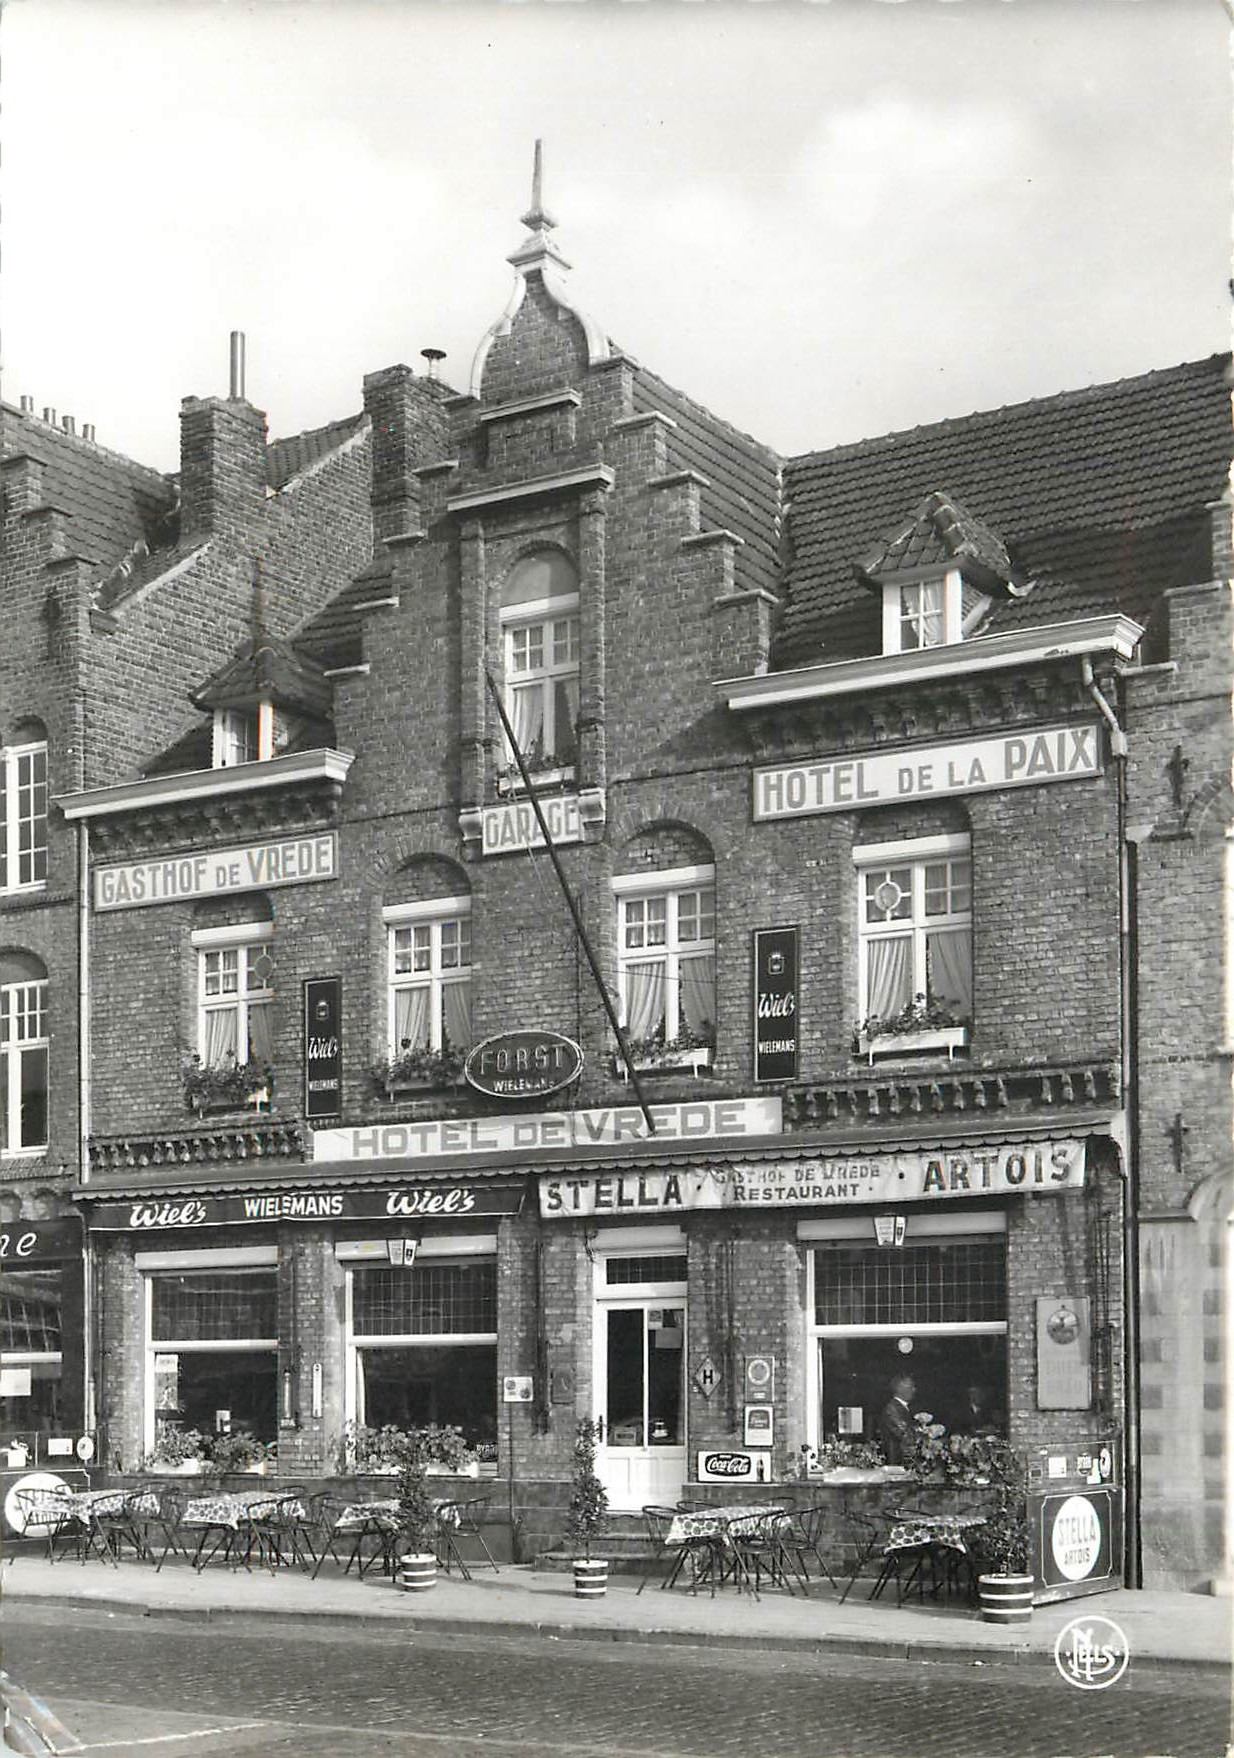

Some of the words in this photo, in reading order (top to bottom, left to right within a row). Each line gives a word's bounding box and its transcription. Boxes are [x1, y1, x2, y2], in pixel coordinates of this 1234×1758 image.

[763, 763, 879, 812] HOTEL
[899, 765, 933, 795] DE
[948, 758, 987, 787] LA
[1004, 729, 1094, 780] PAIX
[101, 858, 207, 903] GASTHOF
[216, 863, 240, 888] DE
[247, 839, 331, 883] VREDE
[481, 1043, 567, 1075] FORST
[758, 1040, 795, 1054] WIELEMANS
[352, 1122, 498, 1157] HOTEL
[513, 1121, 566, 1146] DE
[582, 1102, 746, 1142] VREDE
[547, 1175, 683, 1210] STELLA
[923, 1149, 1073, 1192] ARTOIS
[794, 1167, 816, 1182] DE
[130, 1201, 207, 1227] Wiel's
[244, 1195, 344, 1218] WIELEMANS
[386, 1189, 476, 1214] Wiel's
[734, 1183, 860, 1201] RESTAURANT
[703, 1369, 714, 1384] H
[1057, 1514, 1097, 1547] STELLA
[1064, 1547, 1091, 1566] ARTOIS
